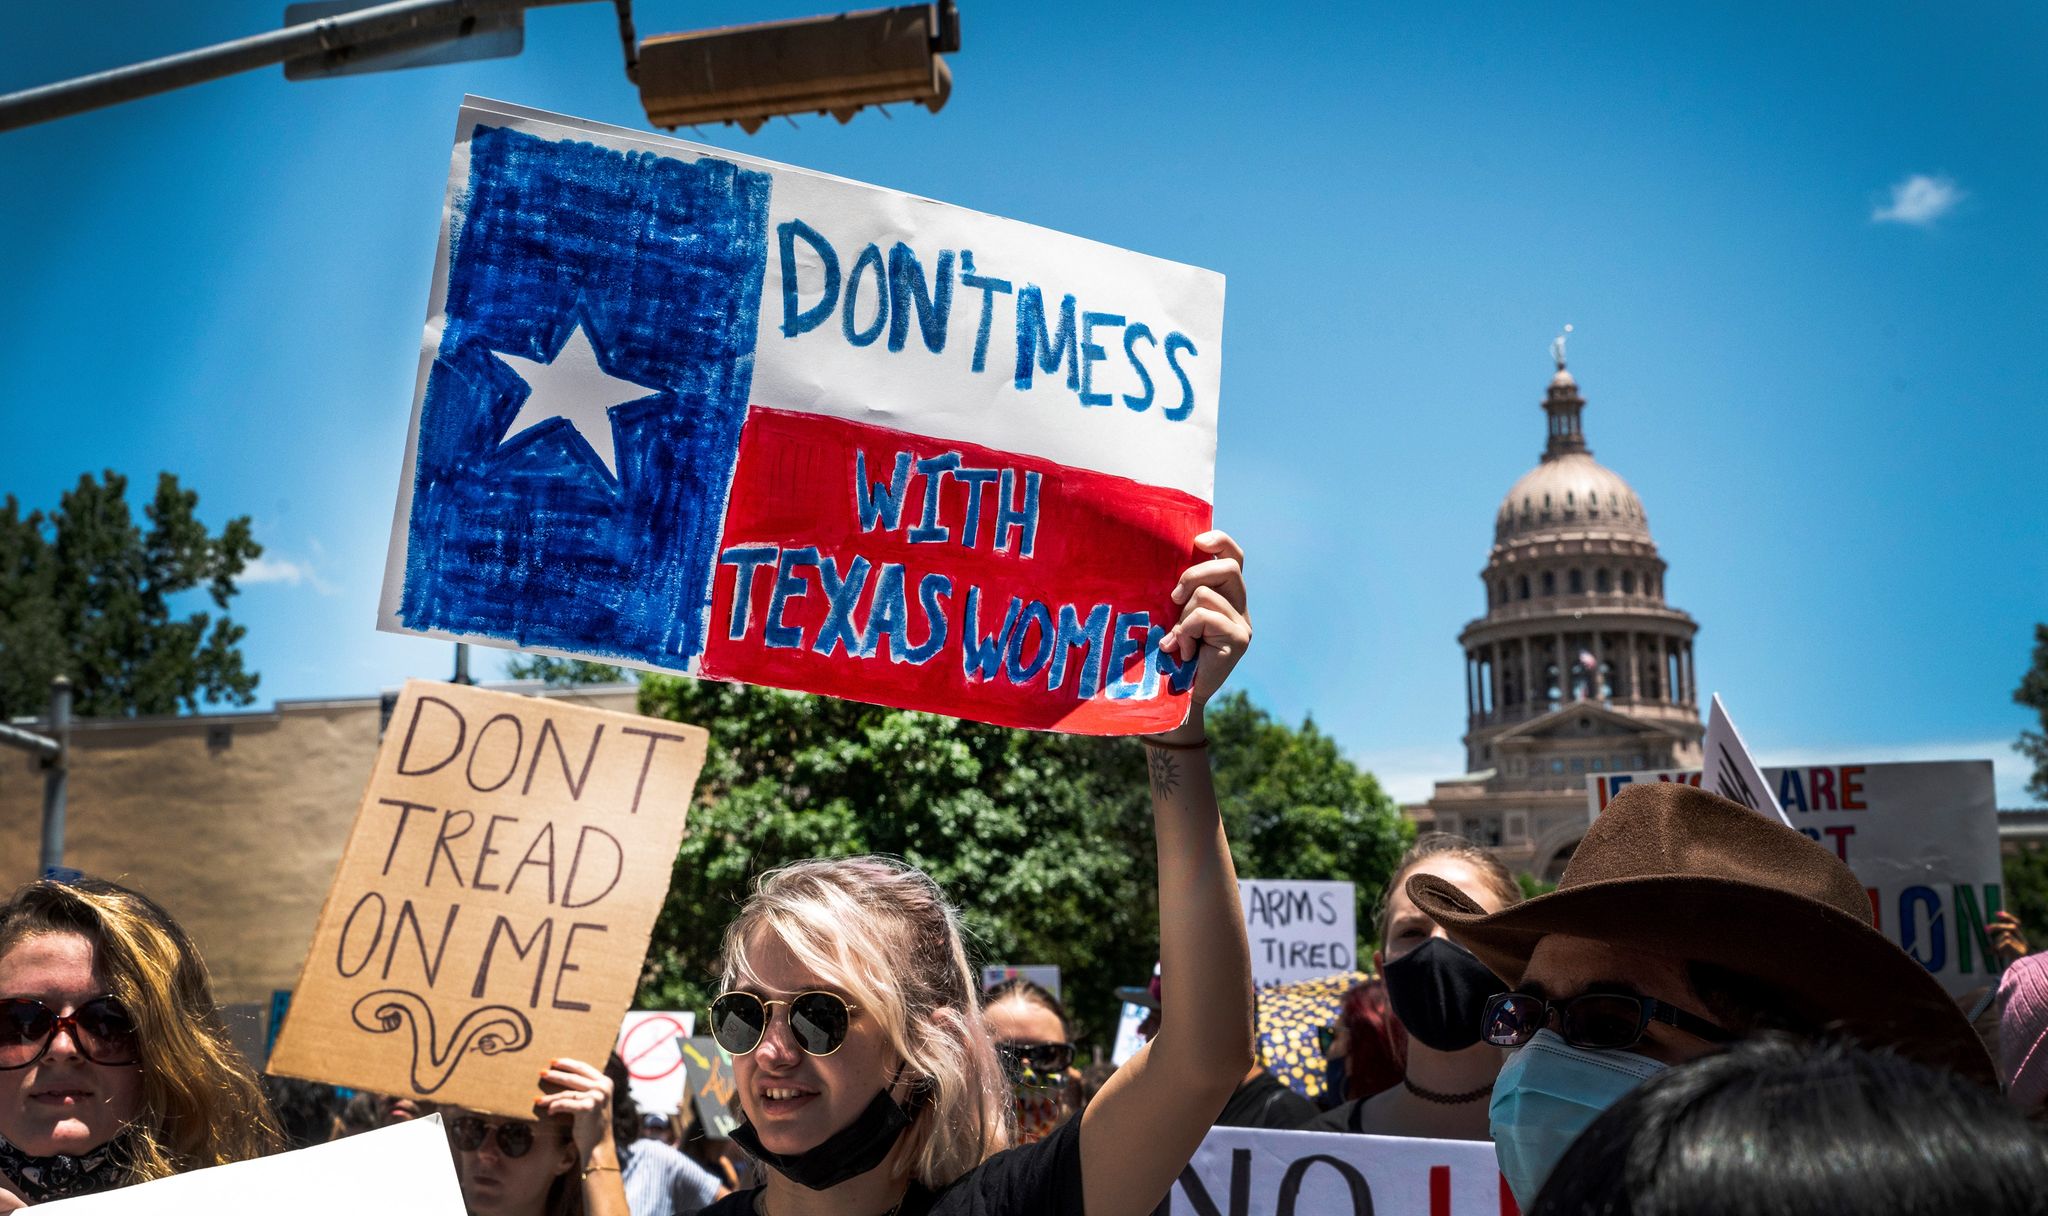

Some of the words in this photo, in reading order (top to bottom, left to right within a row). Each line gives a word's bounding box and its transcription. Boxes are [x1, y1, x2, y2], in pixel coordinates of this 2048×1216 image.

[777, 218, 1012, 374] DON'T
[1014, 282, 1199, 422] MESS
[856, 448, 1043, 558] WITH
[721, 544, 953, 666] TEXAS
[1780, 767, 1868, 813] ARE
[378, 798, 624, 908] TREAD
[1248, 886, 1338, 929] ARMS
[336, 891, 461, 989] ON
[470, 915, 609, 1012] ME
[1260, 938, 1351, 970] TIRED
